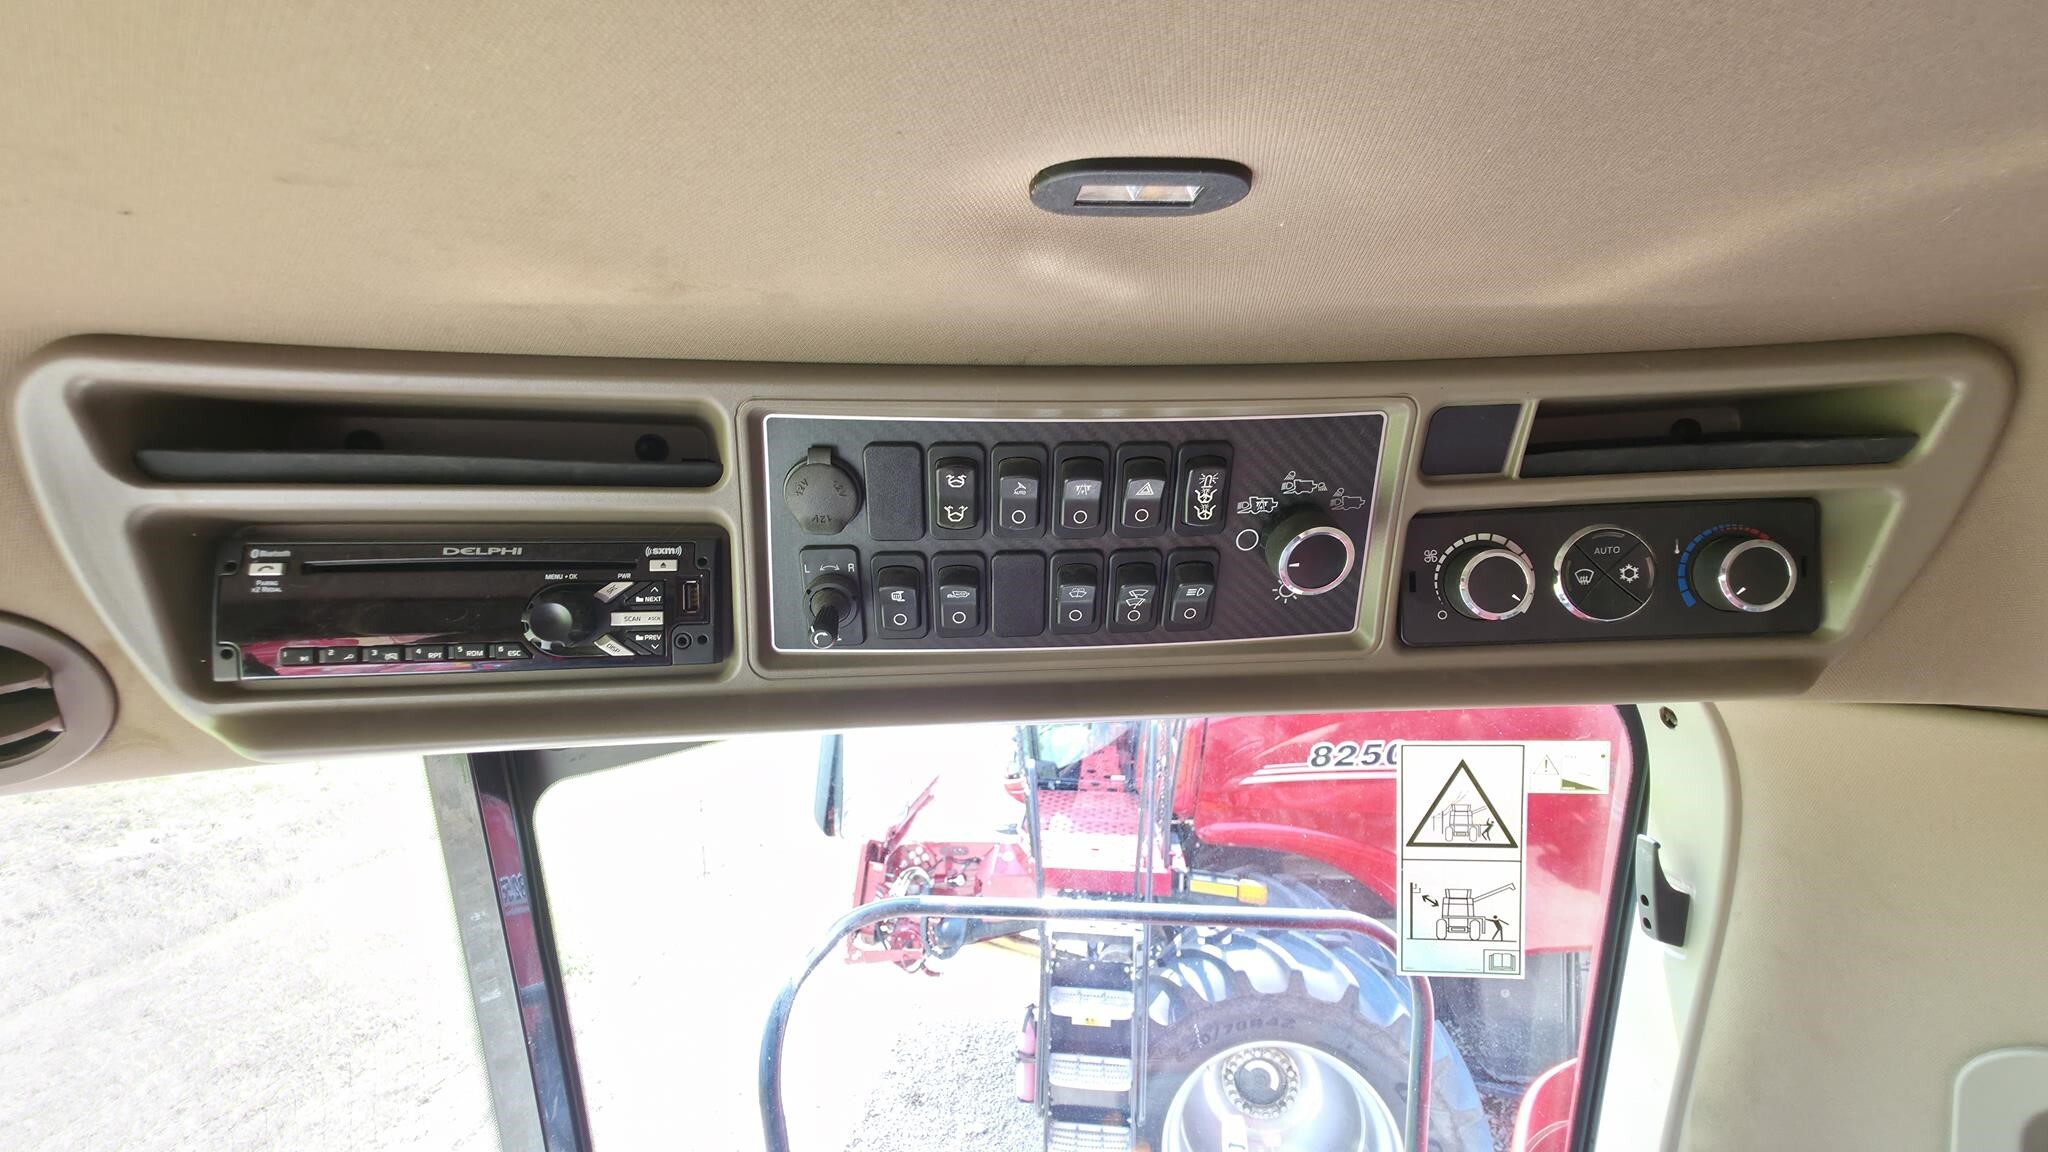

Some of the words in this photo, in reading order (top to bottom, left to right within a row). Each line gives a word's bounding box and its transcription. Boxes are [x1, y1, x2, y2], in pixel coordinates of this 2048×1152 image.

[442, 546, 523, 556] DELPHI
[1593, 544, 1621, 556] AUTO
[804, 564, 811, 574] L
[847, 563, 855, 572] R
[617, 572, 632, 580] PWR
[644, 595, 662, 603] NEXT
[427, 652, 443, 660] RPT
[507, 649, 522, 657] ESC
